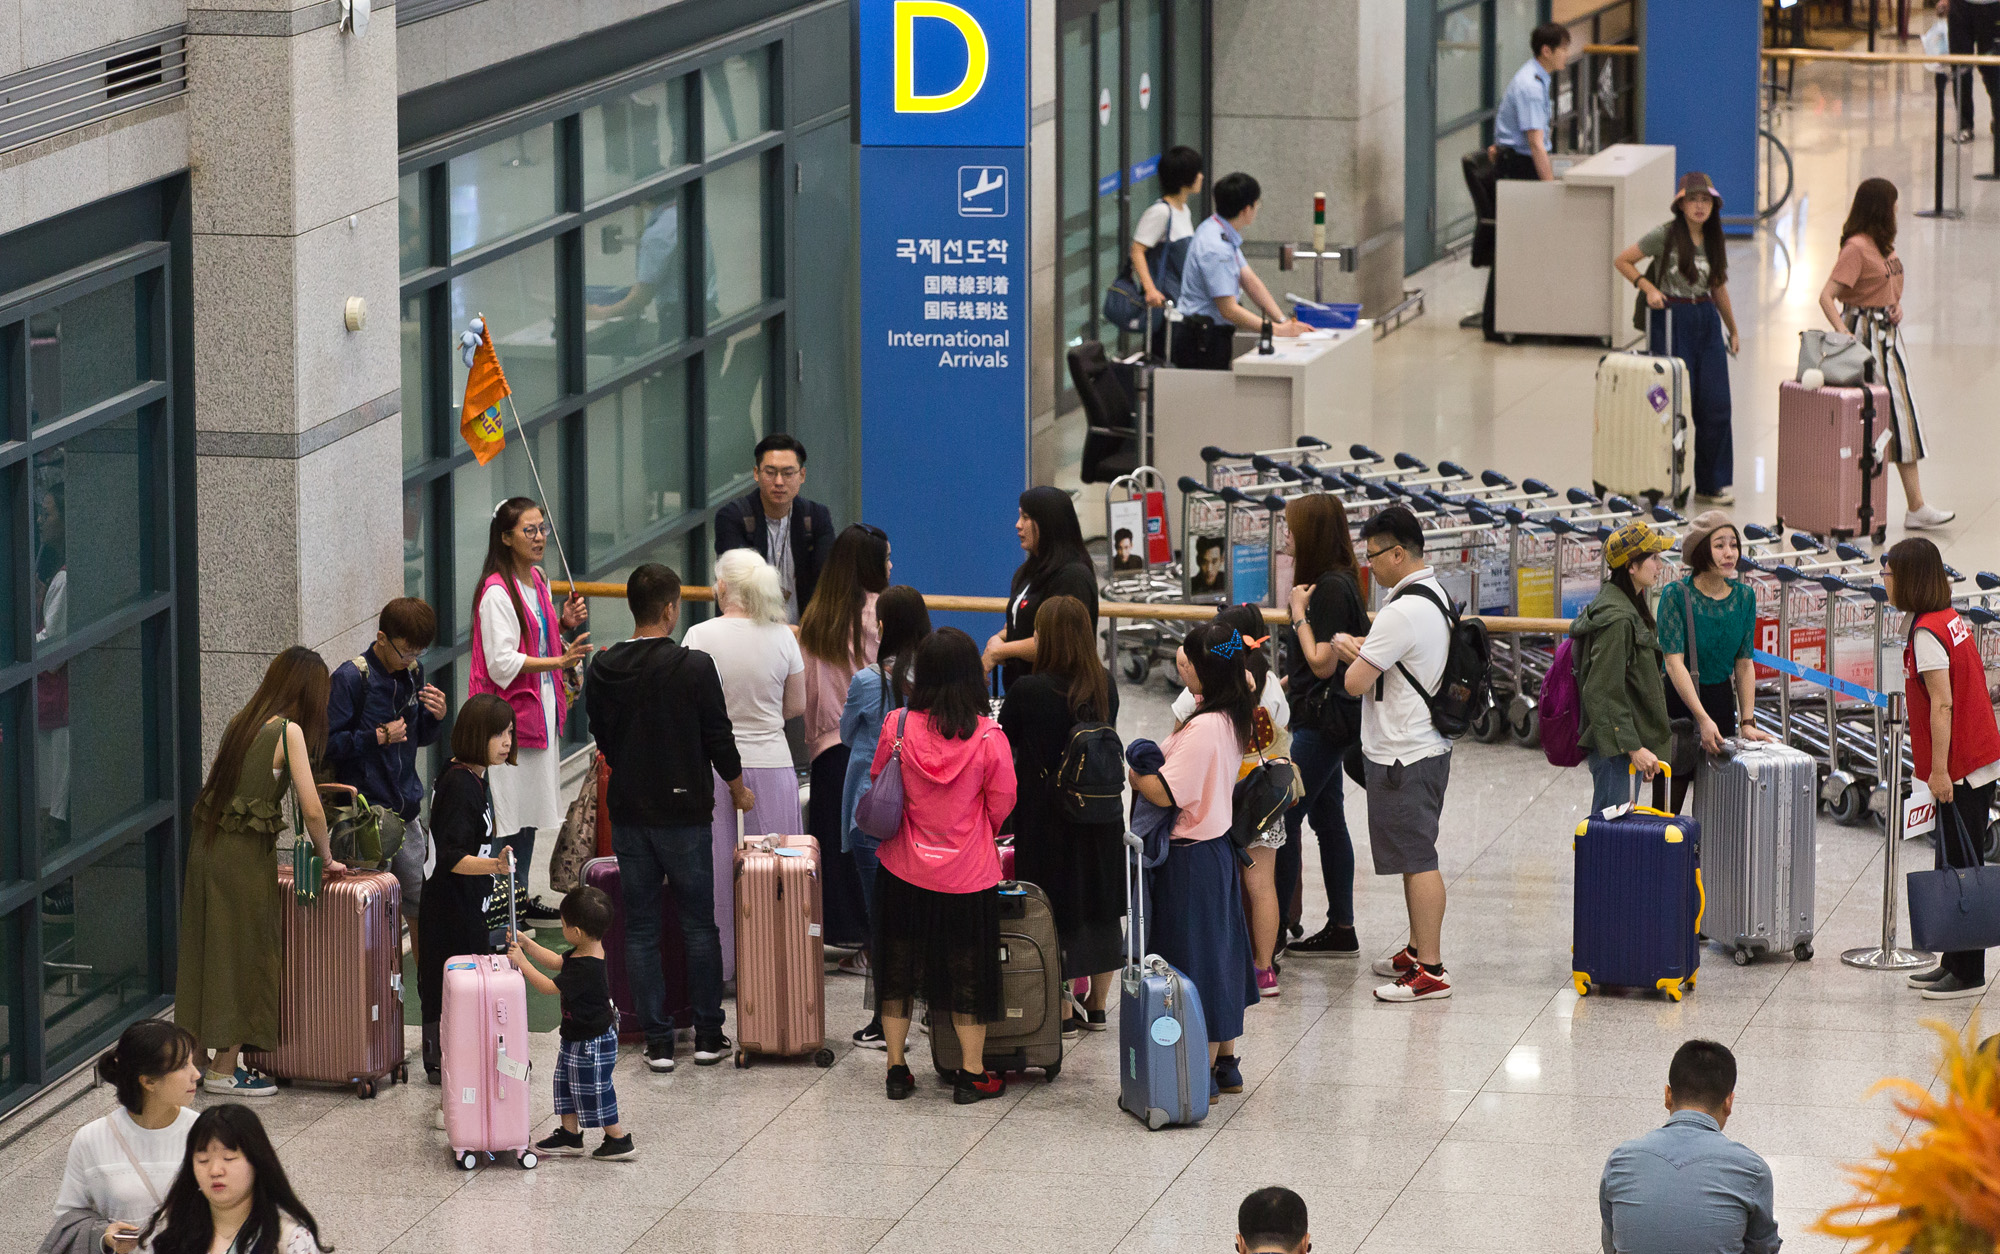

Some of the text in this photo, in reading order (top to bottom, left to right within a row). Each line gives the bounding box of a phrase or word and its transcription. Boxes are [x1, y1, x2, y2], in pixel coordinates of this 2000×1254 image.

[893, 0, 989, 114] D
[896, 238, 1009, 265] 국제선도착
[924, 301, 1009, 321] 国际线到达
[887, 330, 1010, 348] International
[938, 350, 1009, 368] Arrivals
